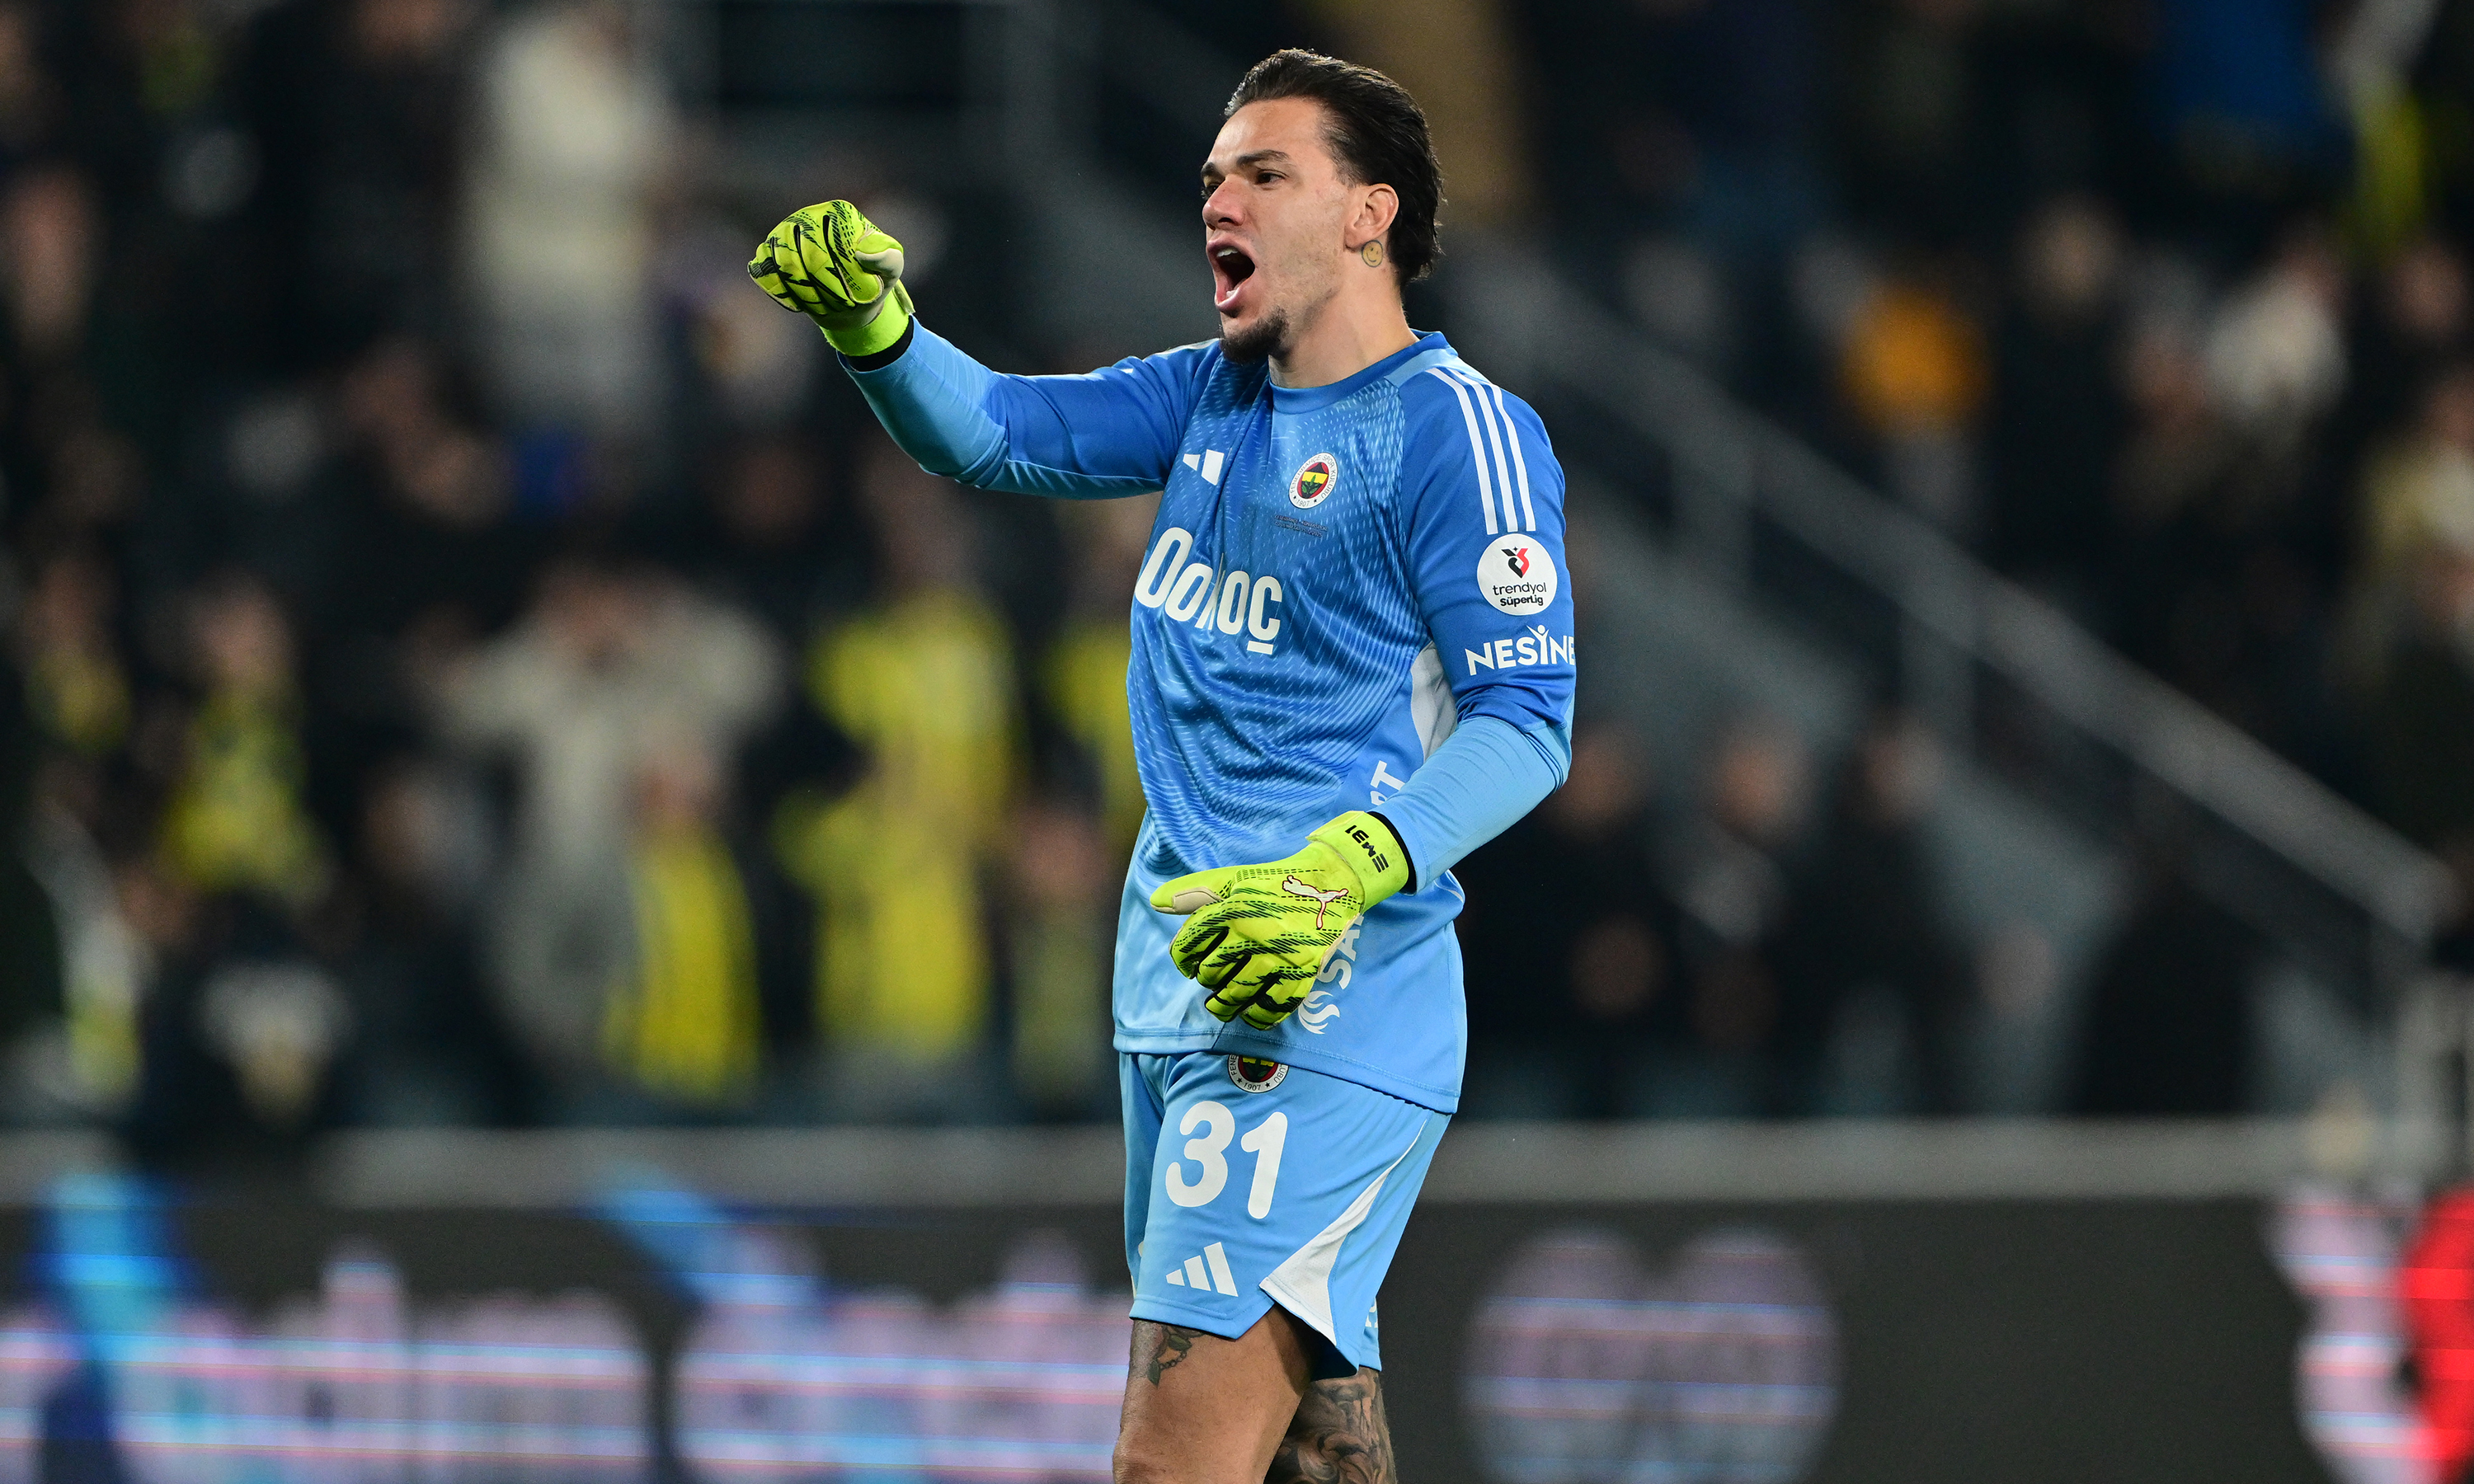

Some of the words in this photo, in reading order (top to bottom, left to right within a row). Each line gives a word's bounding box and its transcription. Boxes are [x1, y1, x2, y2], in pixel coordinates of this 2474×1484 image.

[1296, 499, 1310, 507] 1907
[1493, 582, 1547, 596] trendyol
[1244, 1082, 1262, 1092] 1907
[1165, 1101, 1288, 1219] 31
